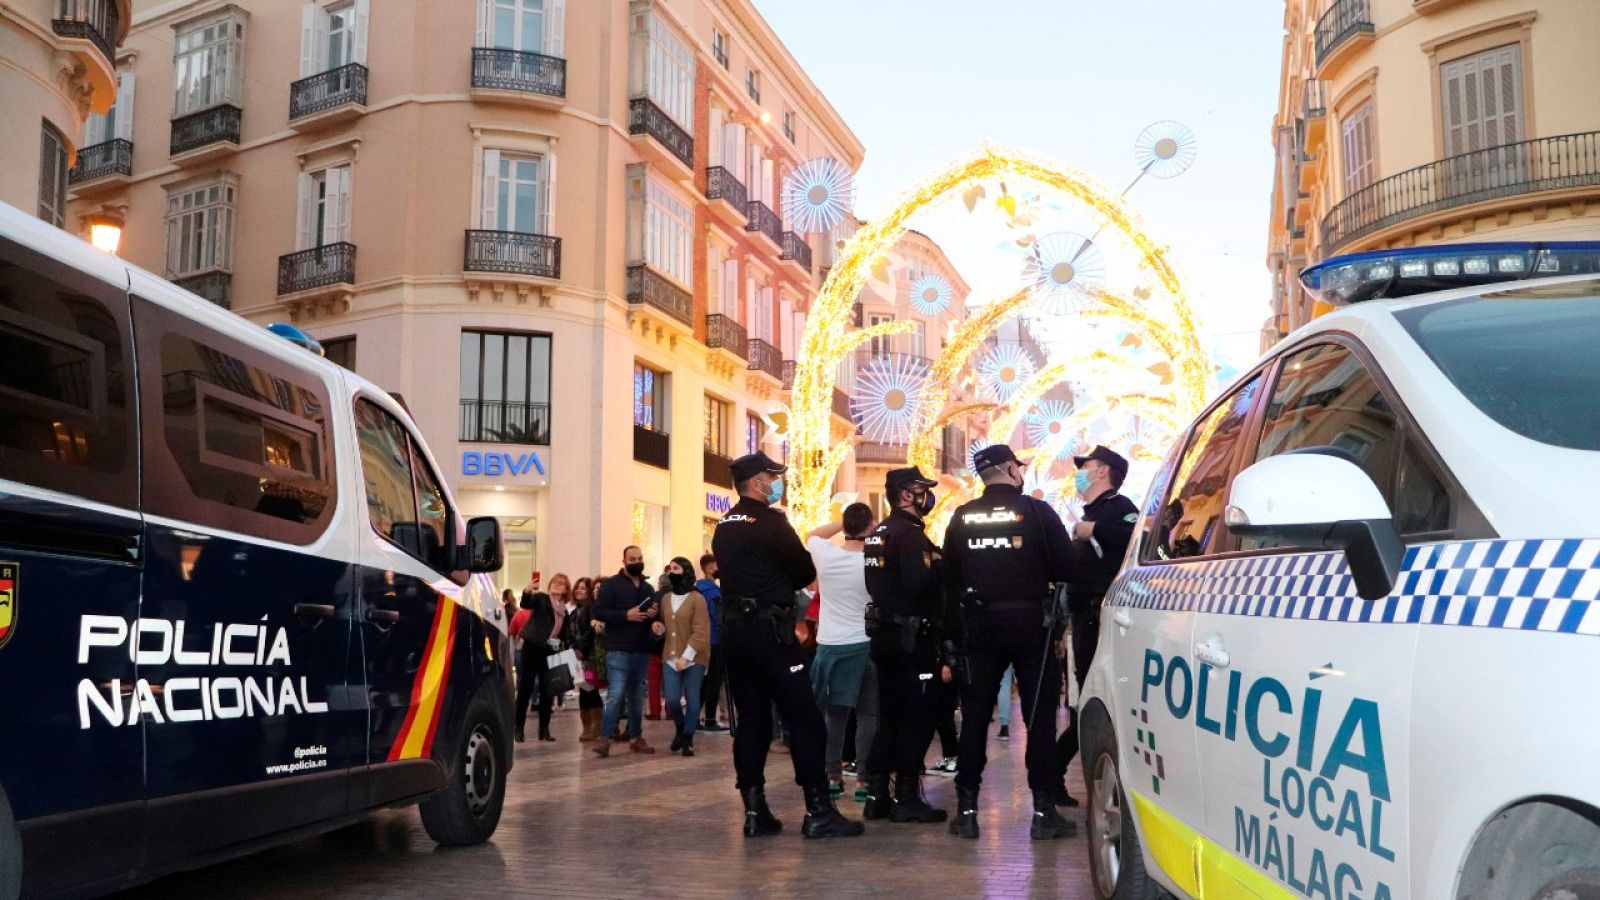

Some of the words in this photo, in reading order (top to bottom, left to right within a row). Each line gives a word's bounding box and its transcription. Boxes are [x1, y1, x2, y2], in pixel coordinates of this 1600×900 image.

[463, 452, 545, 476] BBVA
[706, 492, 730, 512] BBVA
[77, 614, 291, 666] POLICÍA
[77, 676, 328, 729] NACIONAL
[1141, 648, 1391, 803] POLICÍA
[266, 760, 327, 774] www.policia.es
[1263, 758, 1396, 862] LOCAL
